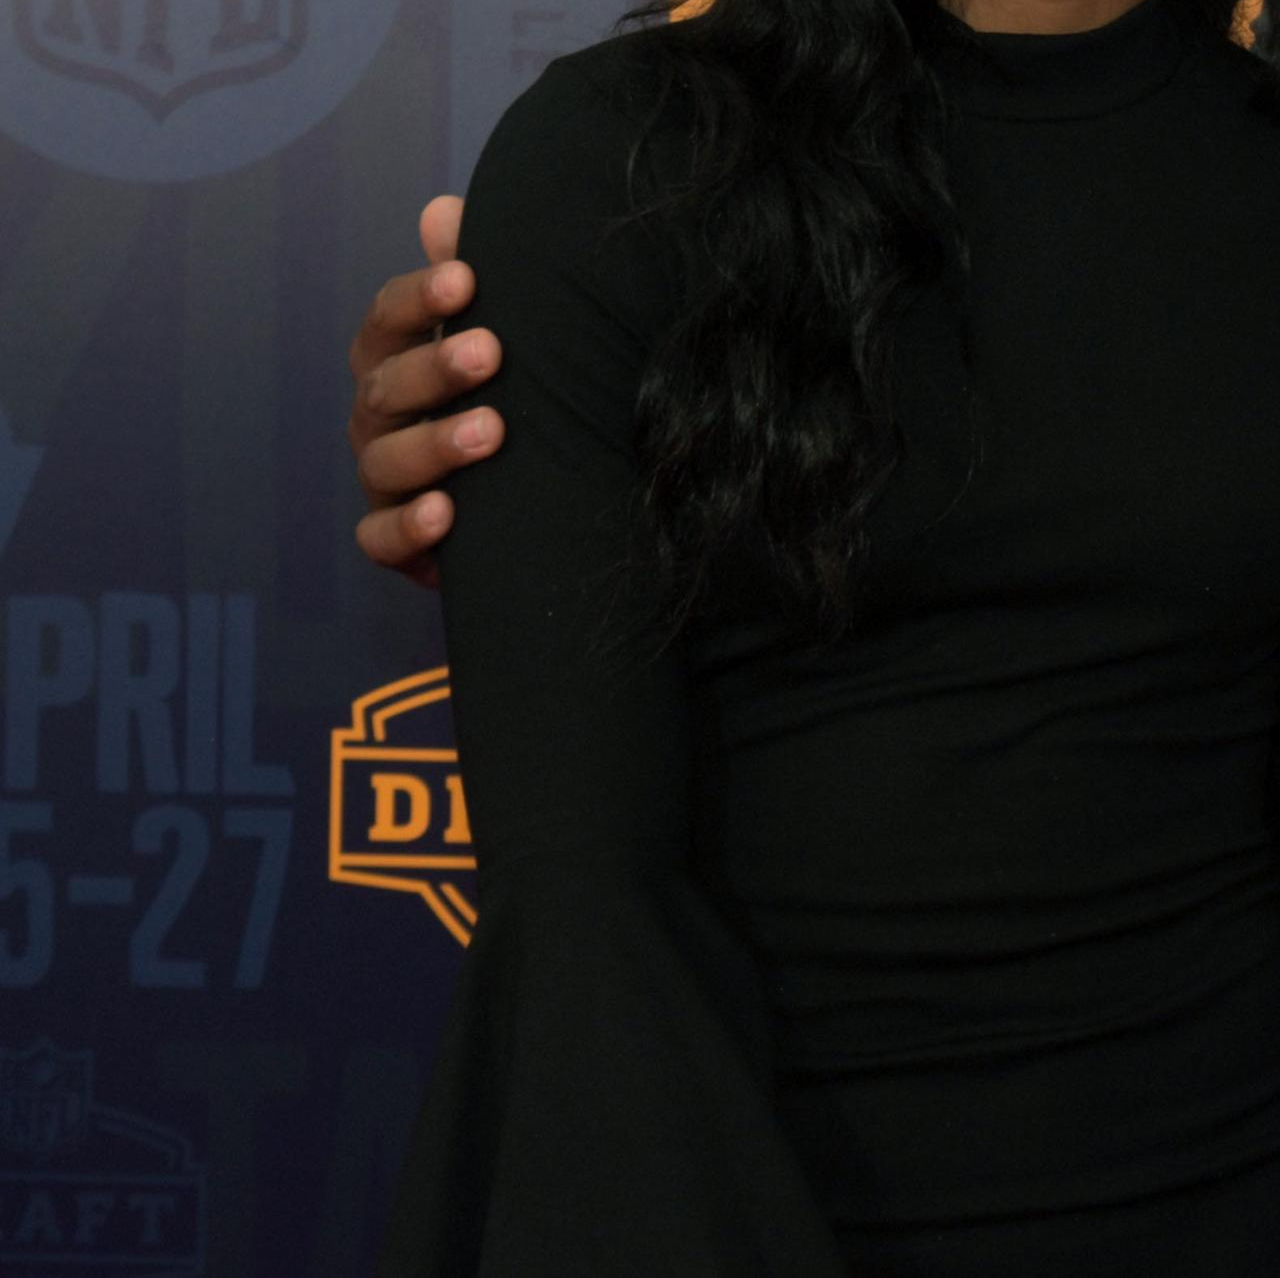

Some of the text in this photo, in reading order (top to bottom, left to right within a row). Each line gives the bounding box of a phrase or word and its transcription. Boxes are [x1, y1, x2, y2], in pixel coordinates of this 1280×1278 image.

[5, 590, 297, 796] PRIL
[0, 800, 296, 990] 5-27
[0, 1191, 178, 1245] AFT
